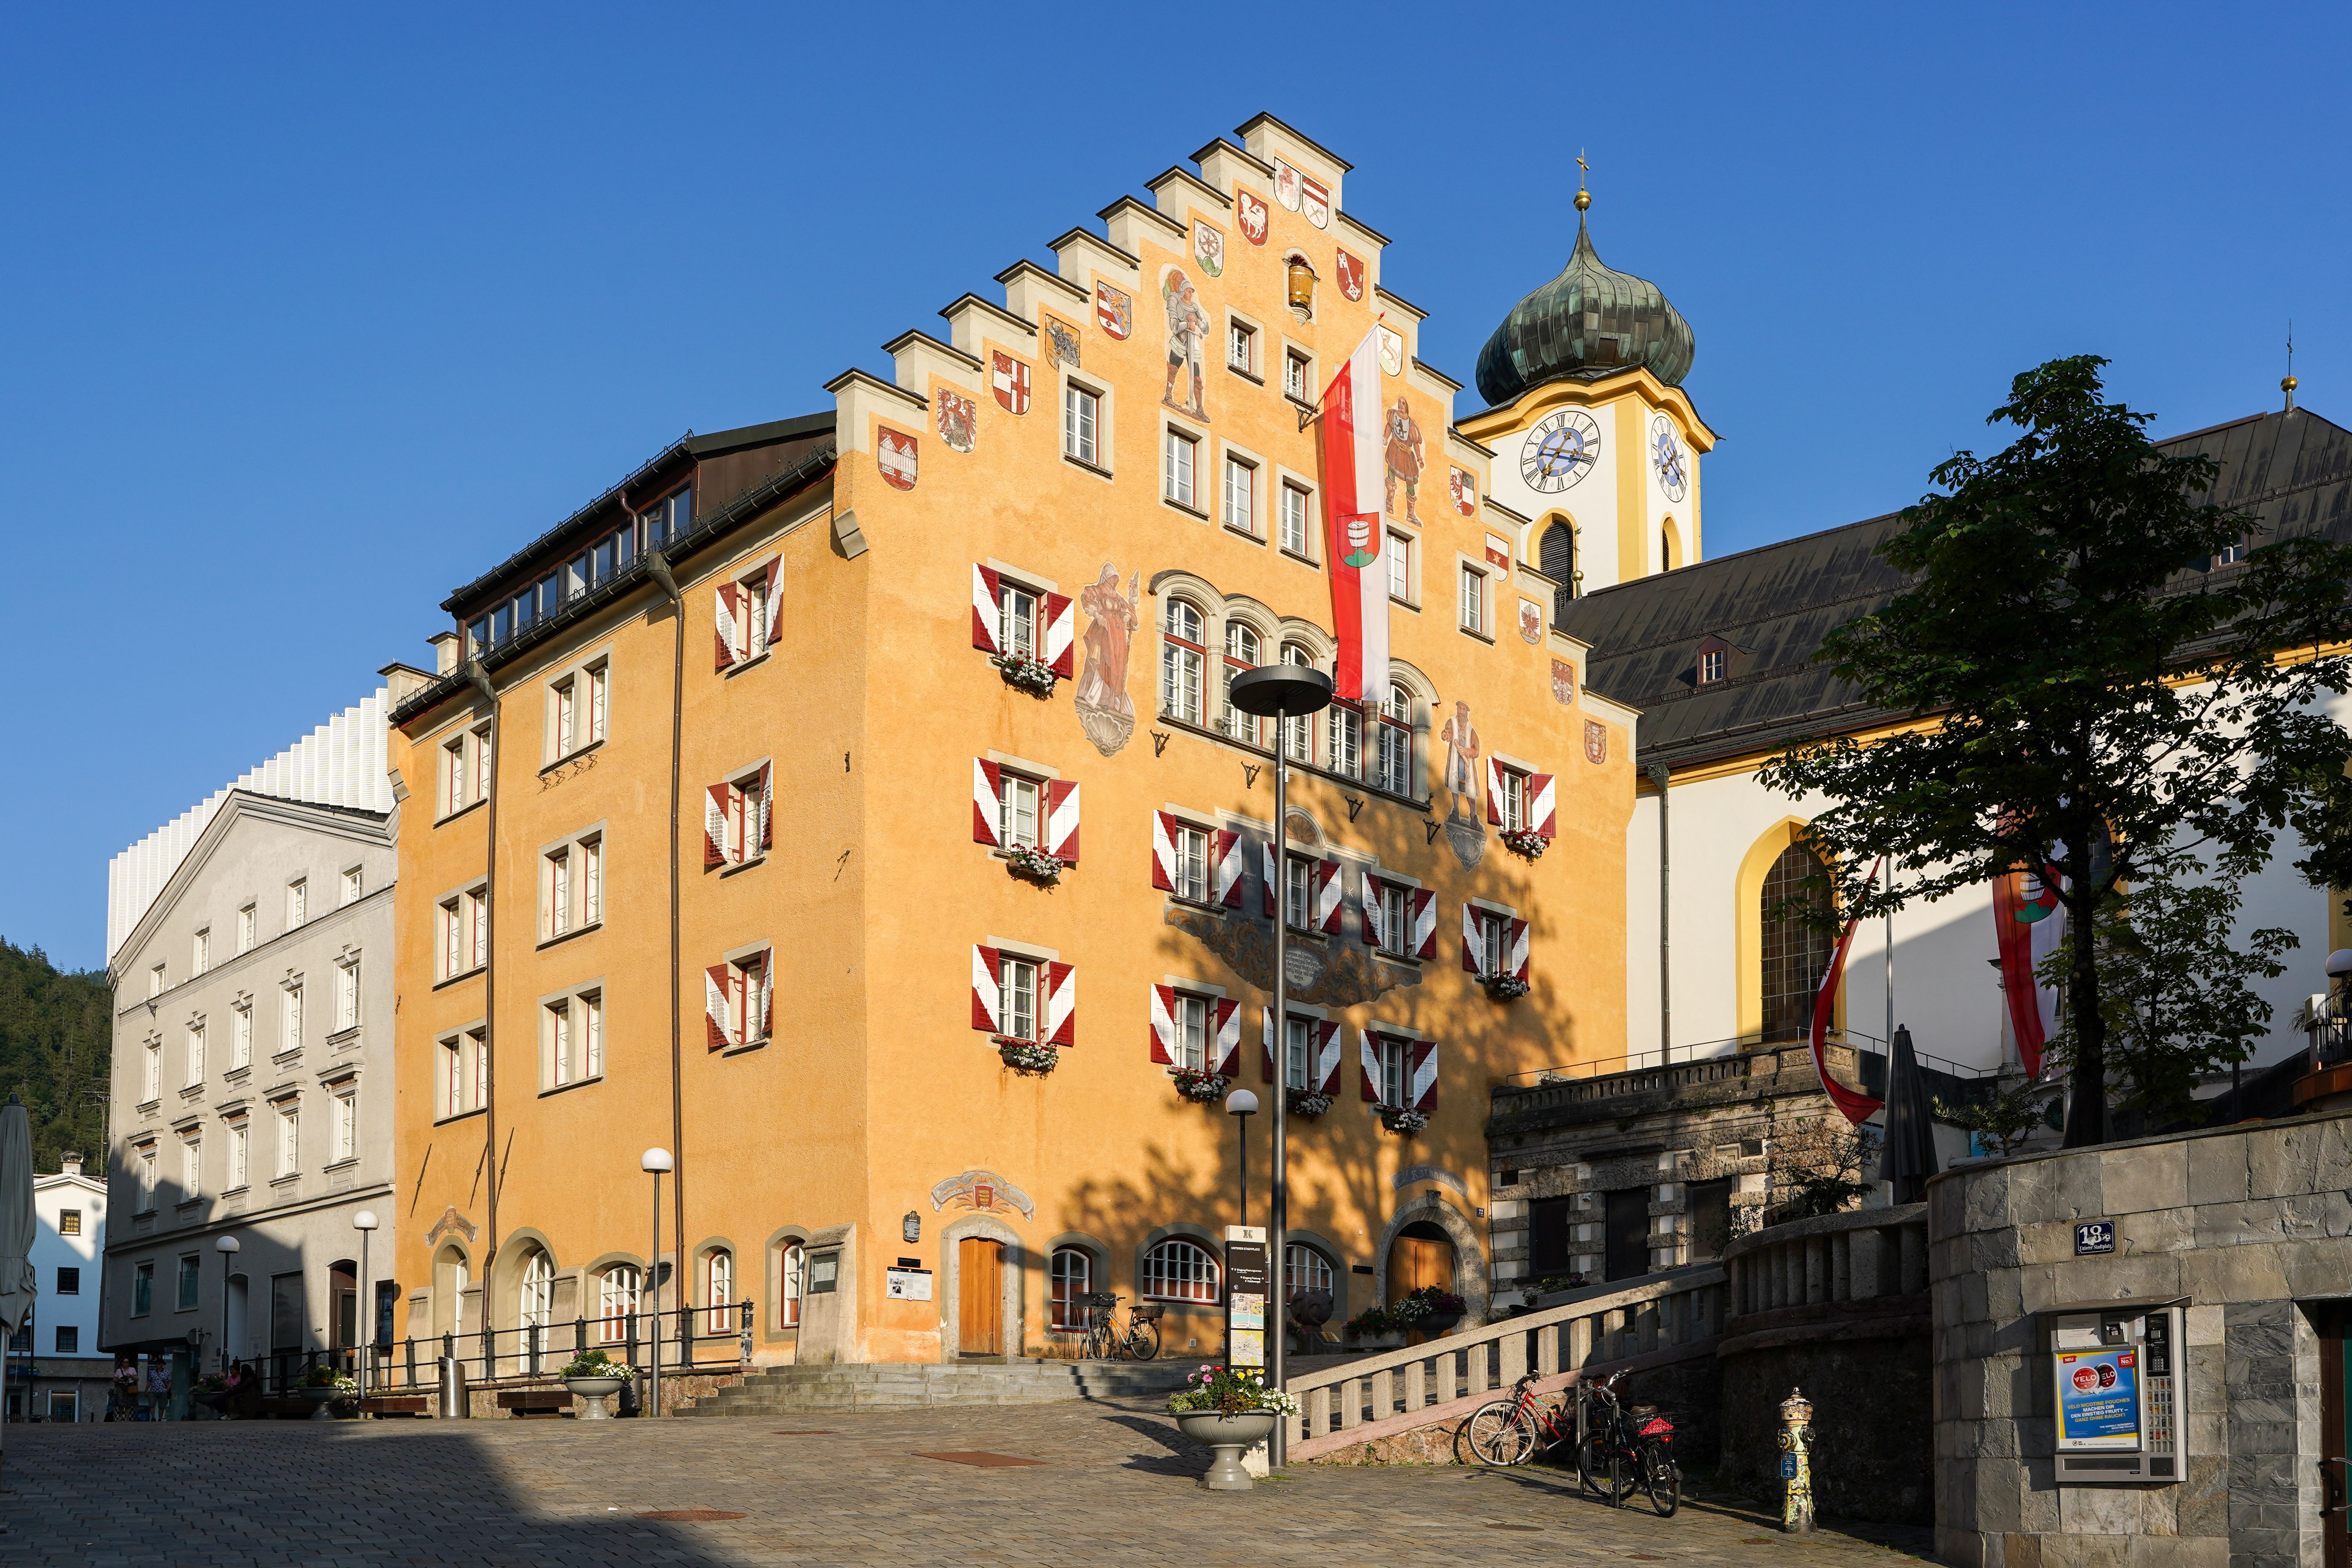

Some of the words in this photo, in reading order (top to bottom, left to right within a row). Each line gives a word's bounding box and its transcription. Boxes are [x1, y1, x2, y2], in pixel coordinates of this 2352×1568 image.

[1556, 414, 1565, 428] XII
[1571, 414, 1579, 427] I
[1539, 423, 1551, 436] XI
[1581, 423, 1593, 434] II
[1527, 439, 1540, 447] X
[1584, 437, 1598, 447] III
[1573, 470, 1581, 480] V
[1411, 1169, 1449, 1183] Rathaus
[1243, 1229, 1253, 1239] K
[2080, 1226, 2102, 1244] 18
[2074, 1374, 2097, 1382] VELO
[2101, 1371, 2115, 1380] ELO
